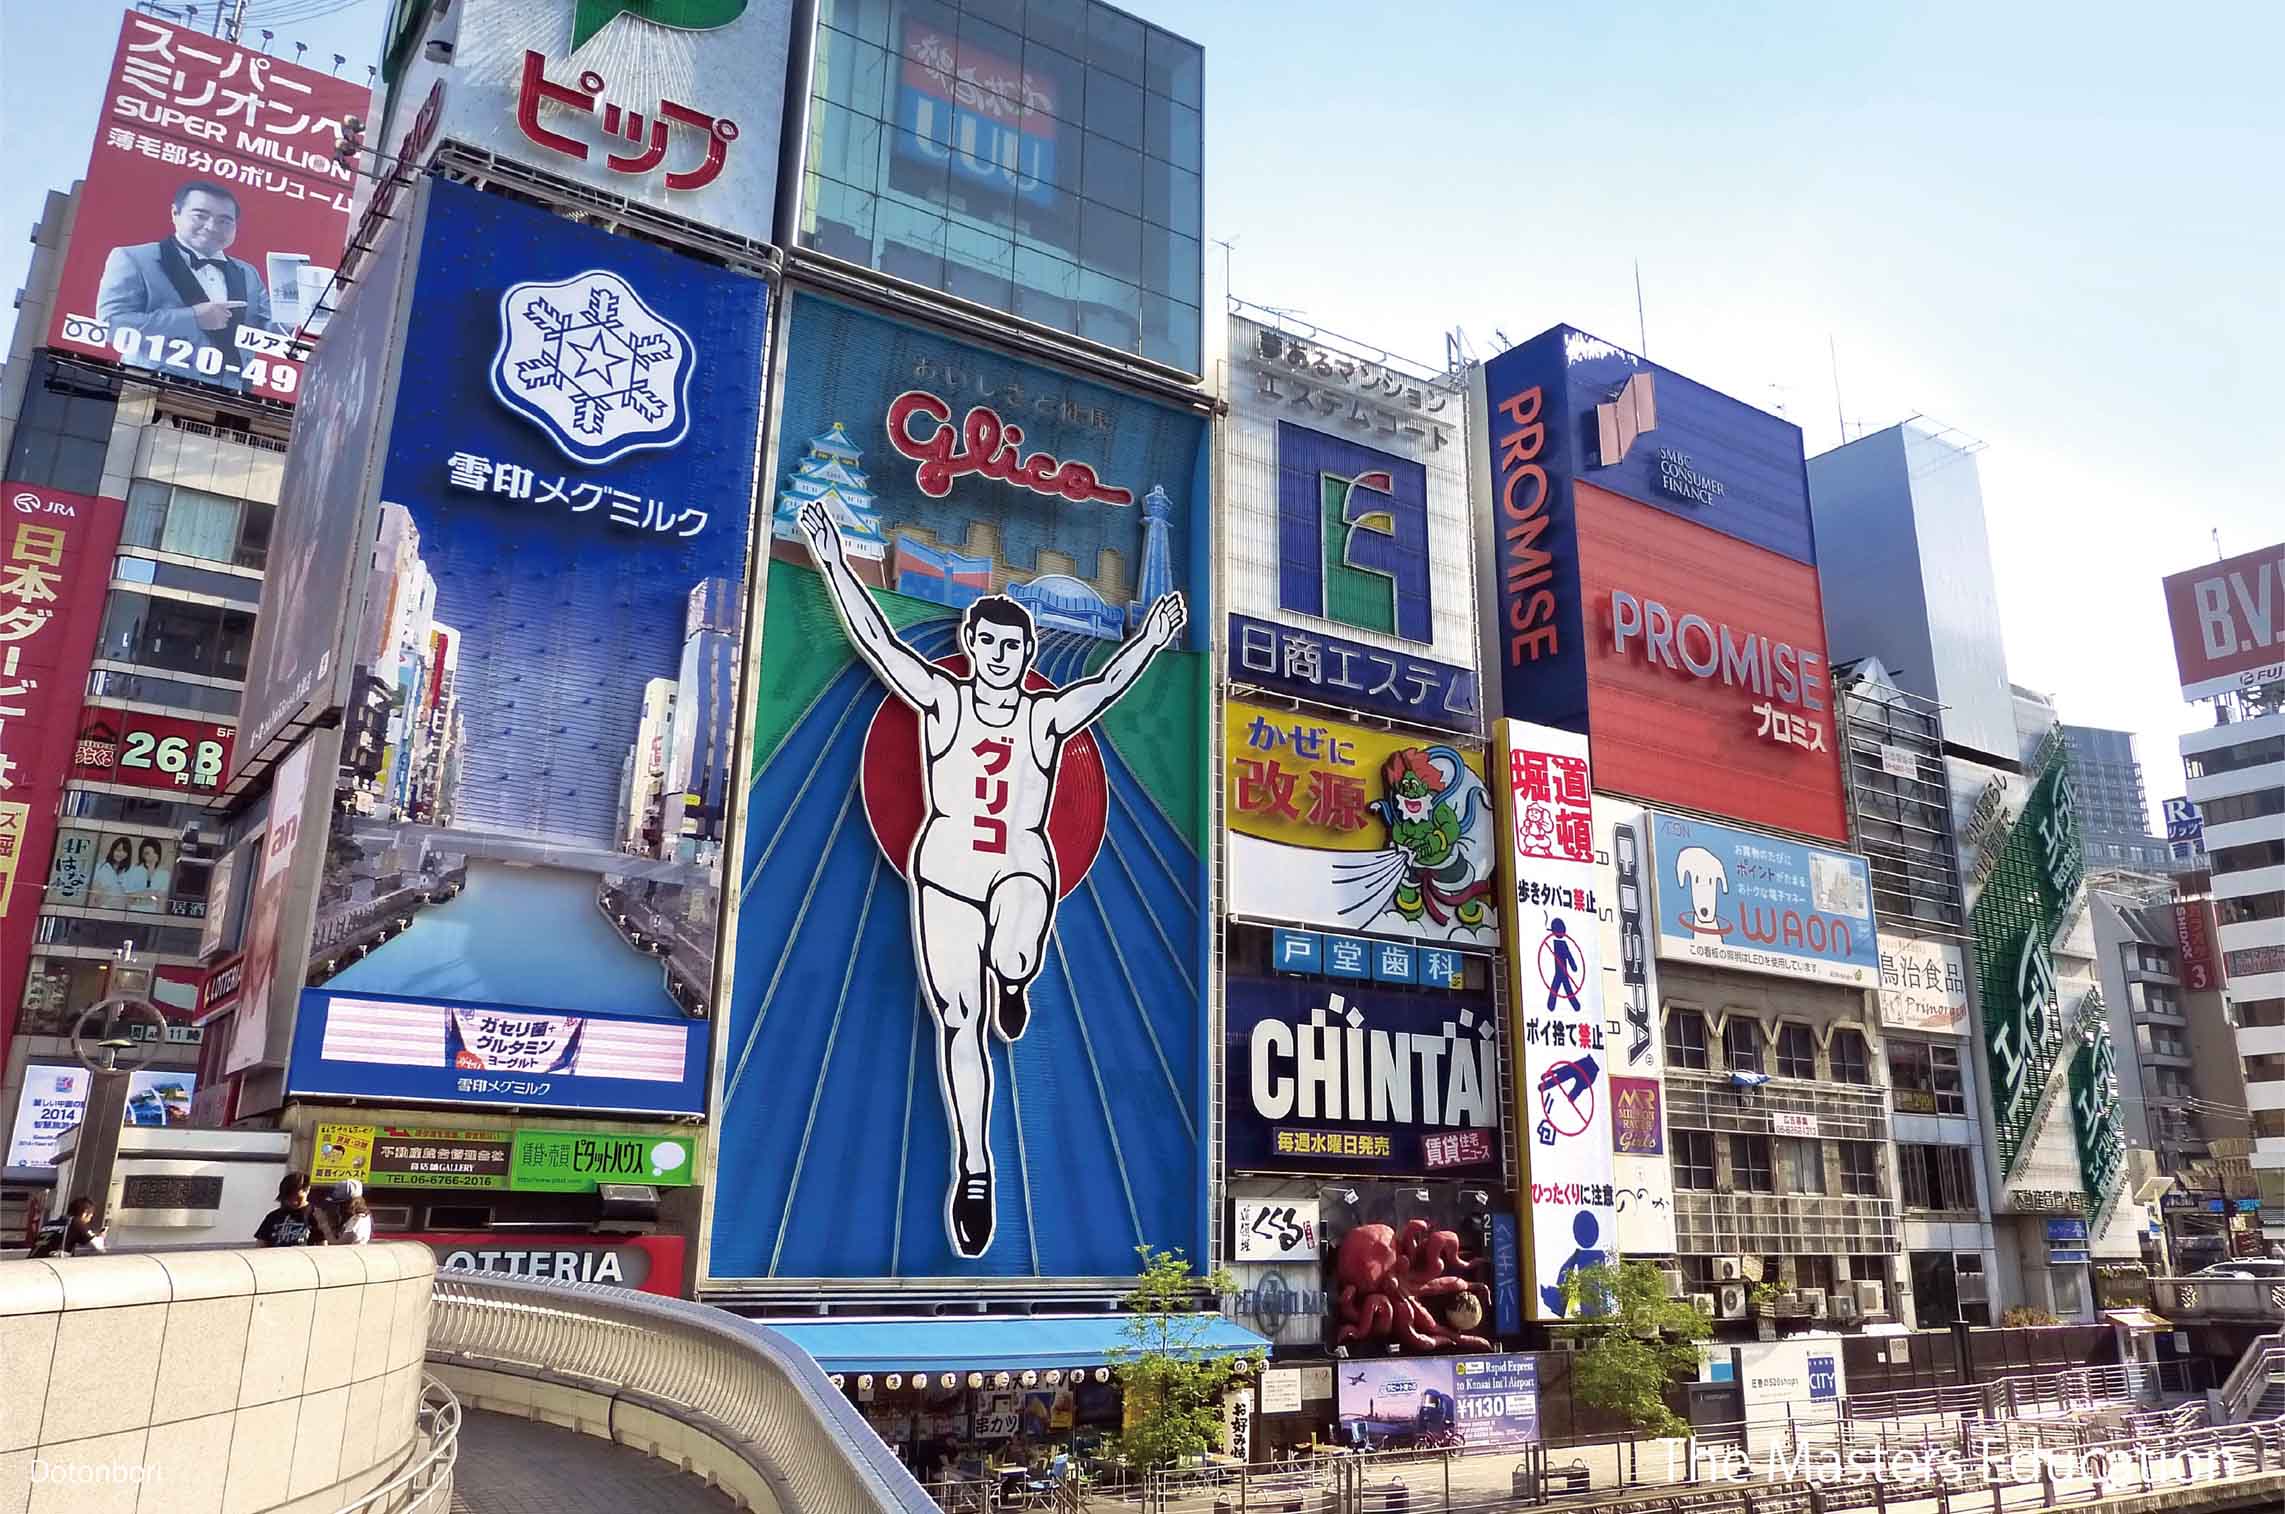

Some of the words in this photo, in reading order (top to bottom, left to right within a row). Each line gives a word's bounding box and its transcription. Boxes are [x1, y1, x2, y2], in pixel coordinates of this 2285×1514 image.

[128, 20, 312, 96] スーパー
[114, 95, 228, 143] SUPER
[236, 135, 351, 182] MILLION
[517, 49, 741, 191] ピップ
[112, 326, 298, 395] 0120-49
[886, 391, 1134, 507] Glico
[1660, 448, 1692, 468] SMBC
[448, 452, 708, 537] 雪印メグミルク
[1661, 461, 1725, 496] CONSUMER
[1664, 475, 1714, 505] FINANCE
[44, 501, 76, 517] JRA
[1497, 385, 1559, 667] PROMISE
[1610, 589, 1824, 711] PROMISE
[1242, 622, 1478, 718] 日商エステム
[1247, 716, 1356, 767] かぜに
[1751, 702, 1828, 753] プロミス
[120, 731, 223, 777] 268
[971, 735, 1015, 855] グリコ
[1232, 755, 1369, 833] 改源
[63, 837, 91, 854] 4F
[1517, 878, 1598, 915] 歩きタバコ禁止
[1738, 901, 1853, 957] WAON
[1283, 934, 1455, 982] 戸堂歯科
[477, 1035, 556, 1055] グルタミン
[488, 1055, 539, 1069] ヨーグルト
[457, 1078, 551, 1096] 雪印メグミルク
[41, 1108, 76, 1121] 2014
[573, 1140, 645, 1175] ピタットハウス
[1276, 1130, 1391, 1157] 毎週水曜日発売
[1530, 1182, 1615, 1206] ひったくりに注意
[445, 1250, 624, 1283] OTTERIA
[1466, 1378, 1491, 1391] Kansai
[1508, 1376, 1535, 1390] Airport
[1485, 1361, 1507, 1376] Rapid
[1507, 1361, 1534, 1375] Express
[1809, 1373, 1835, 1390] CITY
[976, 1415, 1019, 1434] 串カツ
[1230, 1402, 1248, 1463] お好み焼
